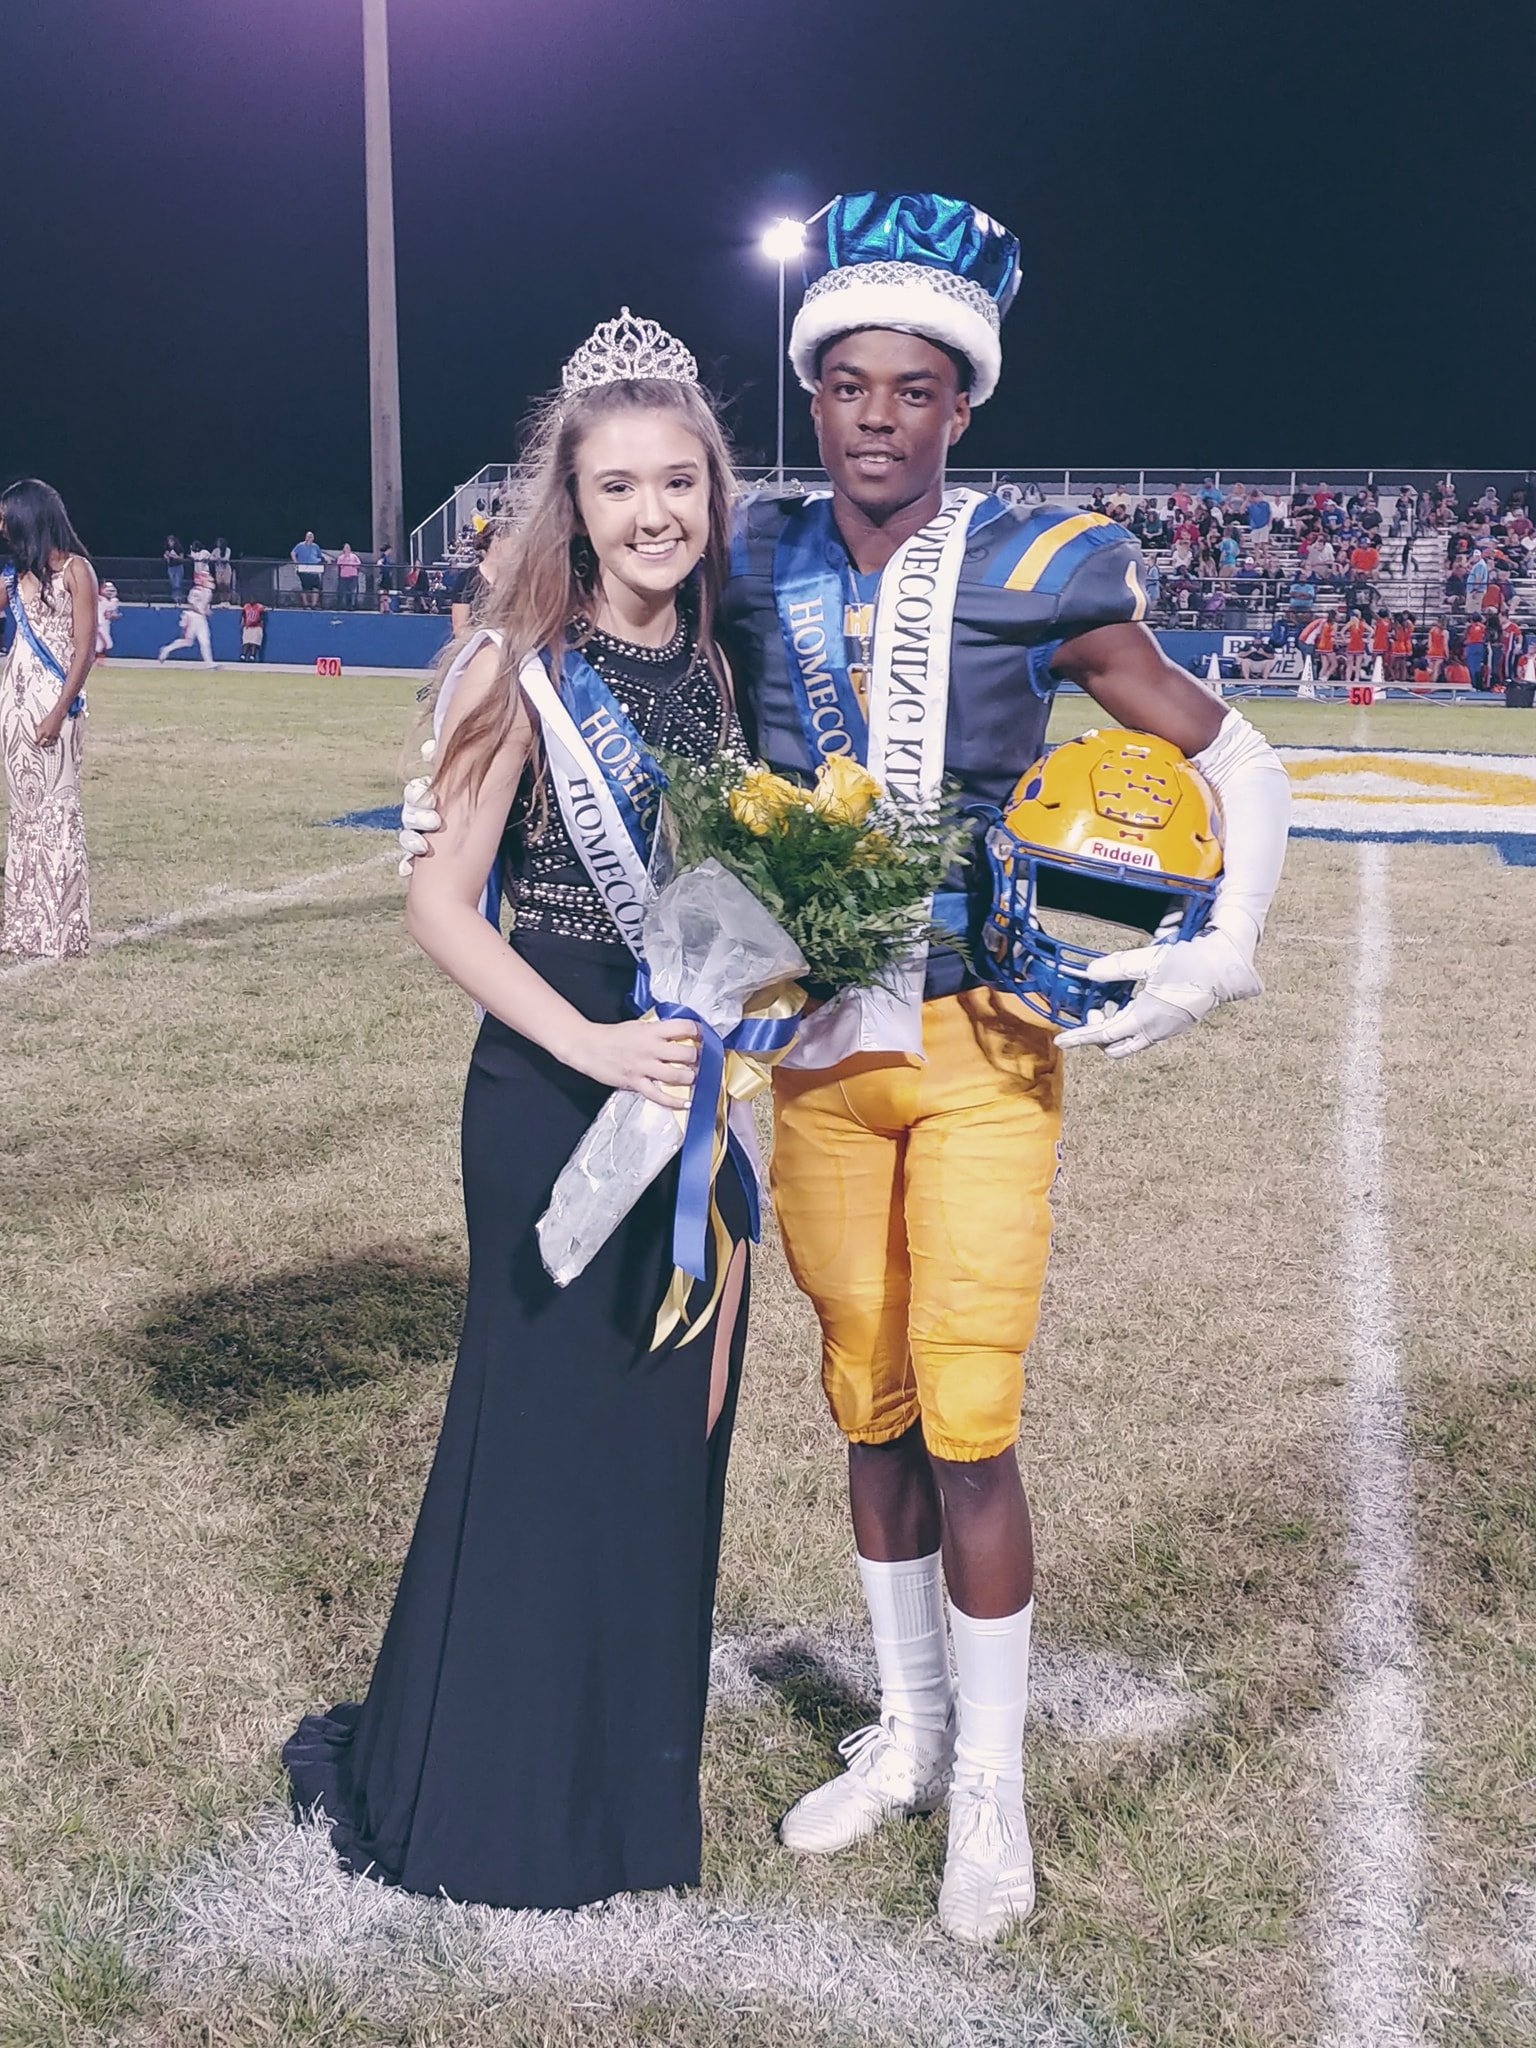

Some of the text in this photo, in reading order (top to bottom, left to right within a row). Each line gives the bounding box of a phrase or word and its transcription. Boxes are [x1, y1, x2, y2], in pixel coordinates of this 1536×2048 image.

[318, 658, 338, 676] 30
[788, 596, 858, 761] HOMECO
[1351, 687, 1373, 706] 50
[580, 704, 657, 840] HOMEC
[1092, 842, 1154, 867] Riddell
